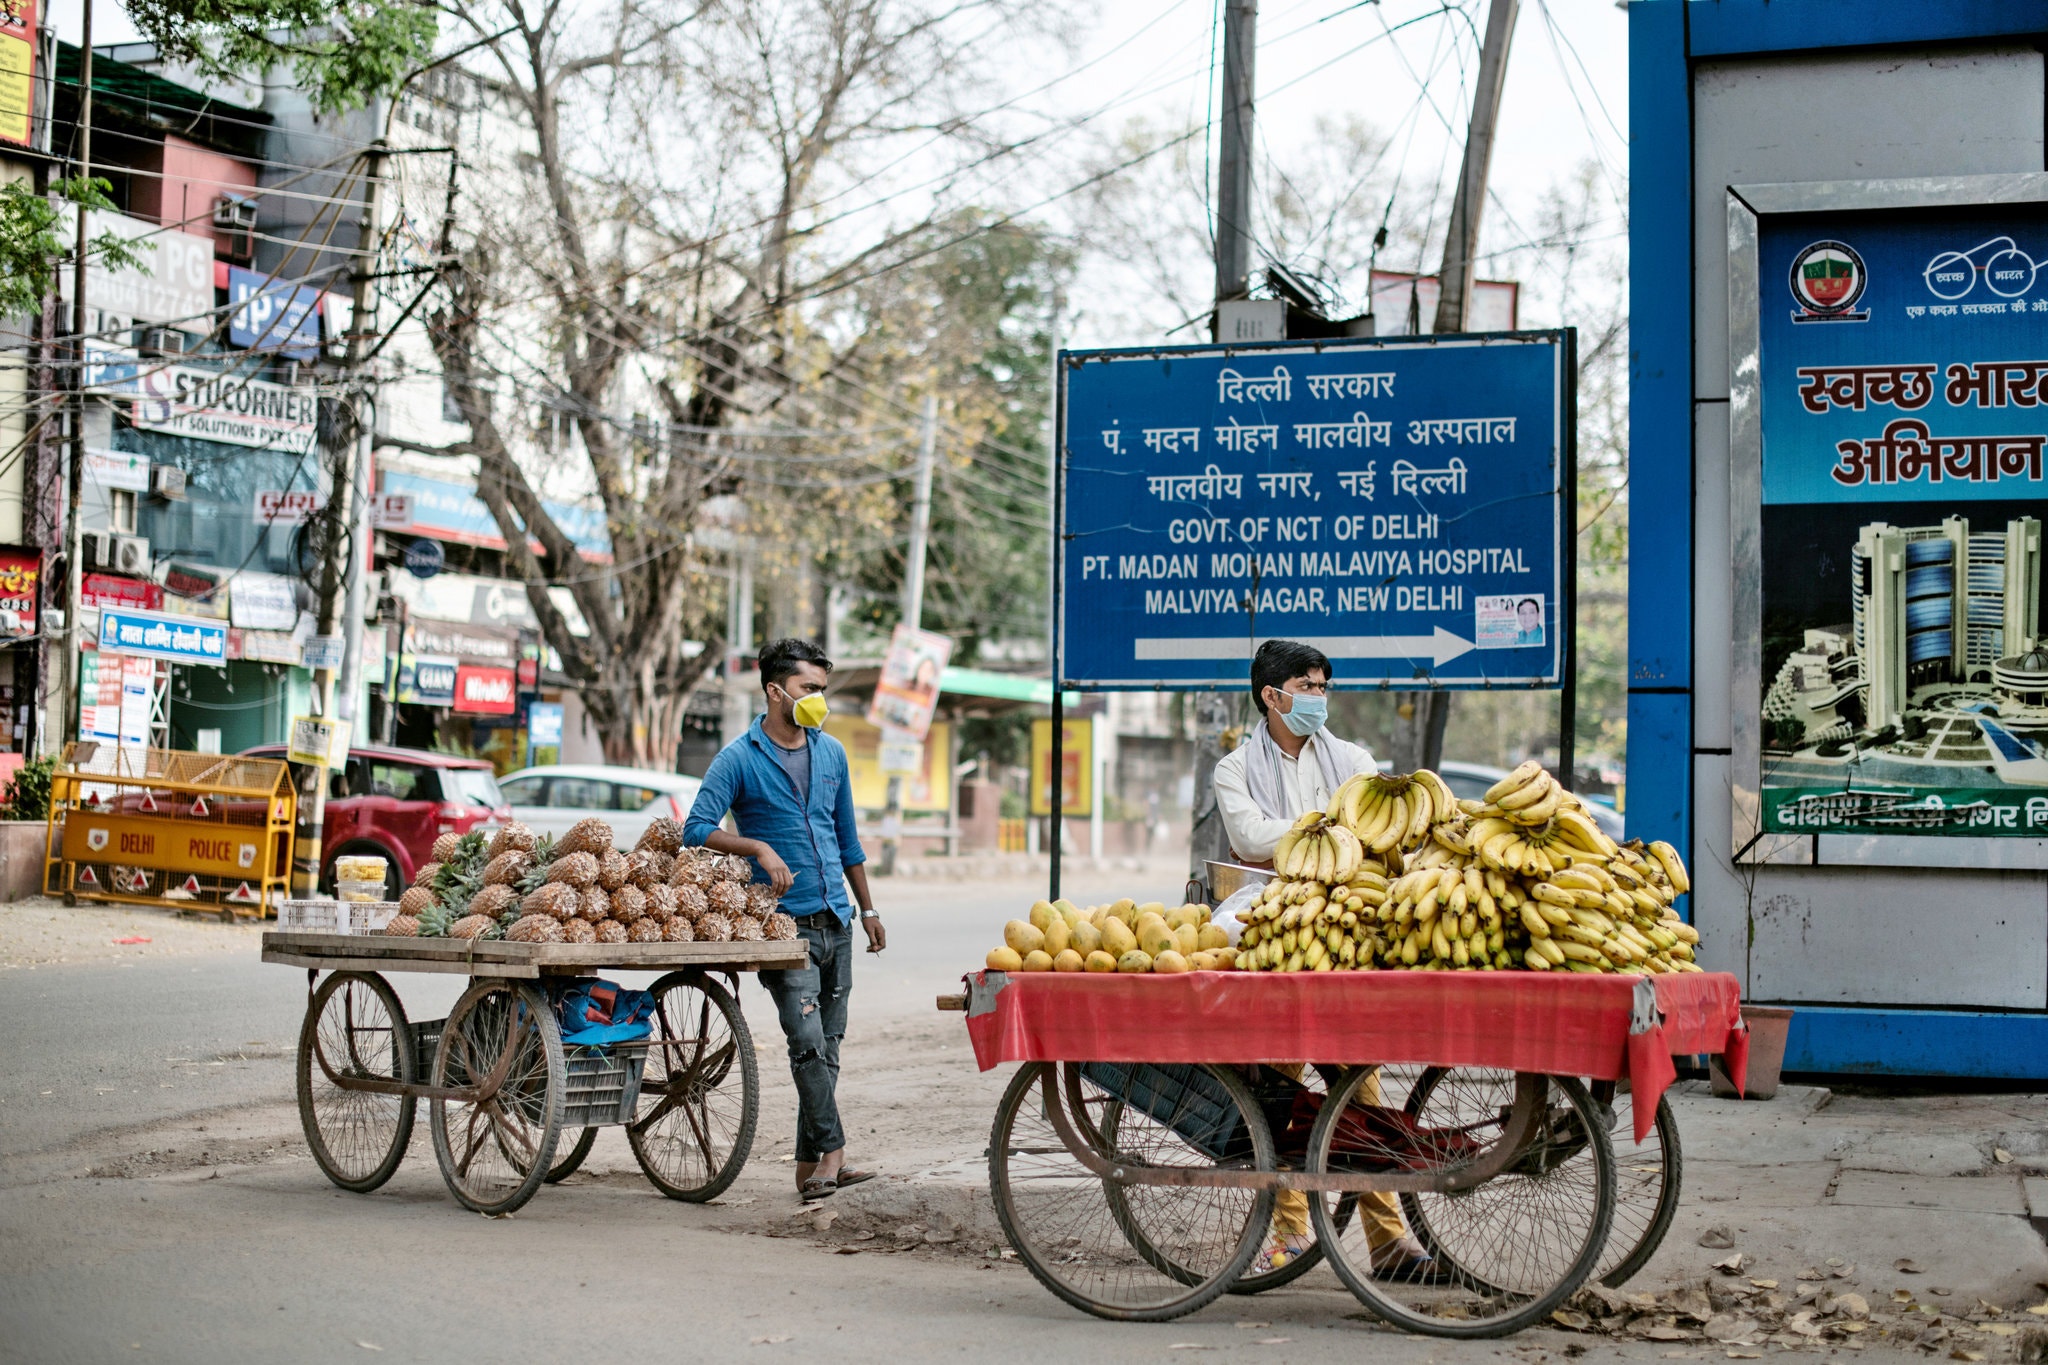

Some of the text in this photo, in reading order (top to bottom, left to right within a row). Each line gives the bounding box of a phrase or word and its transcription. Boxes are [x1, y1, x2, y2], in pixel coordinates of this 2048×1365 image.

[167, 239, 207, 290] PG
[1995, 270, 2025, 281] भारत
[233, 283, 272, 335] JP
[1906, 306, 1926, 319] एक
[1929, 305, 1958, 316] कदम
[2011, 298, 2027, 313] की
[175, 373, 313, 424] STUCORNER
[1218, 365, 1396, 403] दिल्ली सरकार
[1797, 364, 1938, 413] स्वच्छ
[189, 418, 255, 440] SOLUTIONS
[1102, 411, 1517, 454] पं. मदन मोहन मालवीय अस्पताल
[1831, 418, 2047, 486] अभियान
[1147, 457, 1468, 502] मालवीय नगर, नई दिल्ली
[1169, 514, 1438, 543] GOVT. OF NCT OF DELHI
[1083, 548, 1530, 580] PT. MADAN MOHAN MALAVIYA HOSPITAL
[1145, 585, 1462, 617] MALVIYA NAGAR, NEW DELHI
[121, 832, 232, 862] DELHI POLICE
